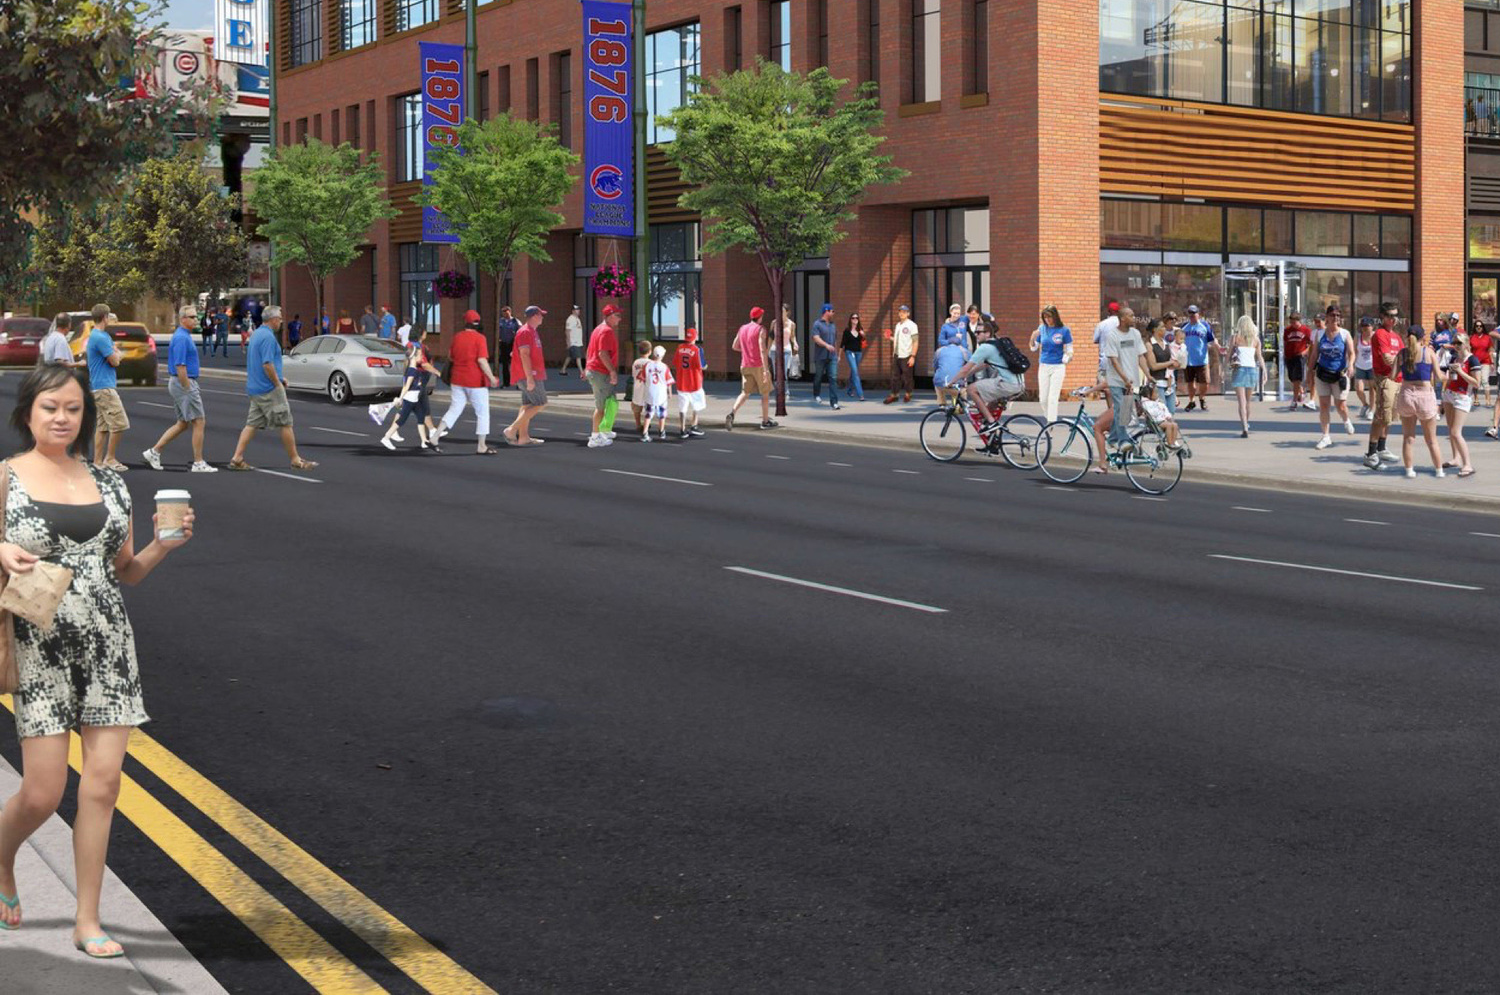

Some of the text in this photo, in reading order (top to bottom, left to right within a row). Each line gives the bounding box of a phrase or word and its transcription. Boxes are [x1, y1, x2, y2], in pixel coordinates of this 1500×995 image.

[426, 57, 461, 149] 1876
[588, 17, 628, 124] 1876
[682, 355, 690, 369] 5
